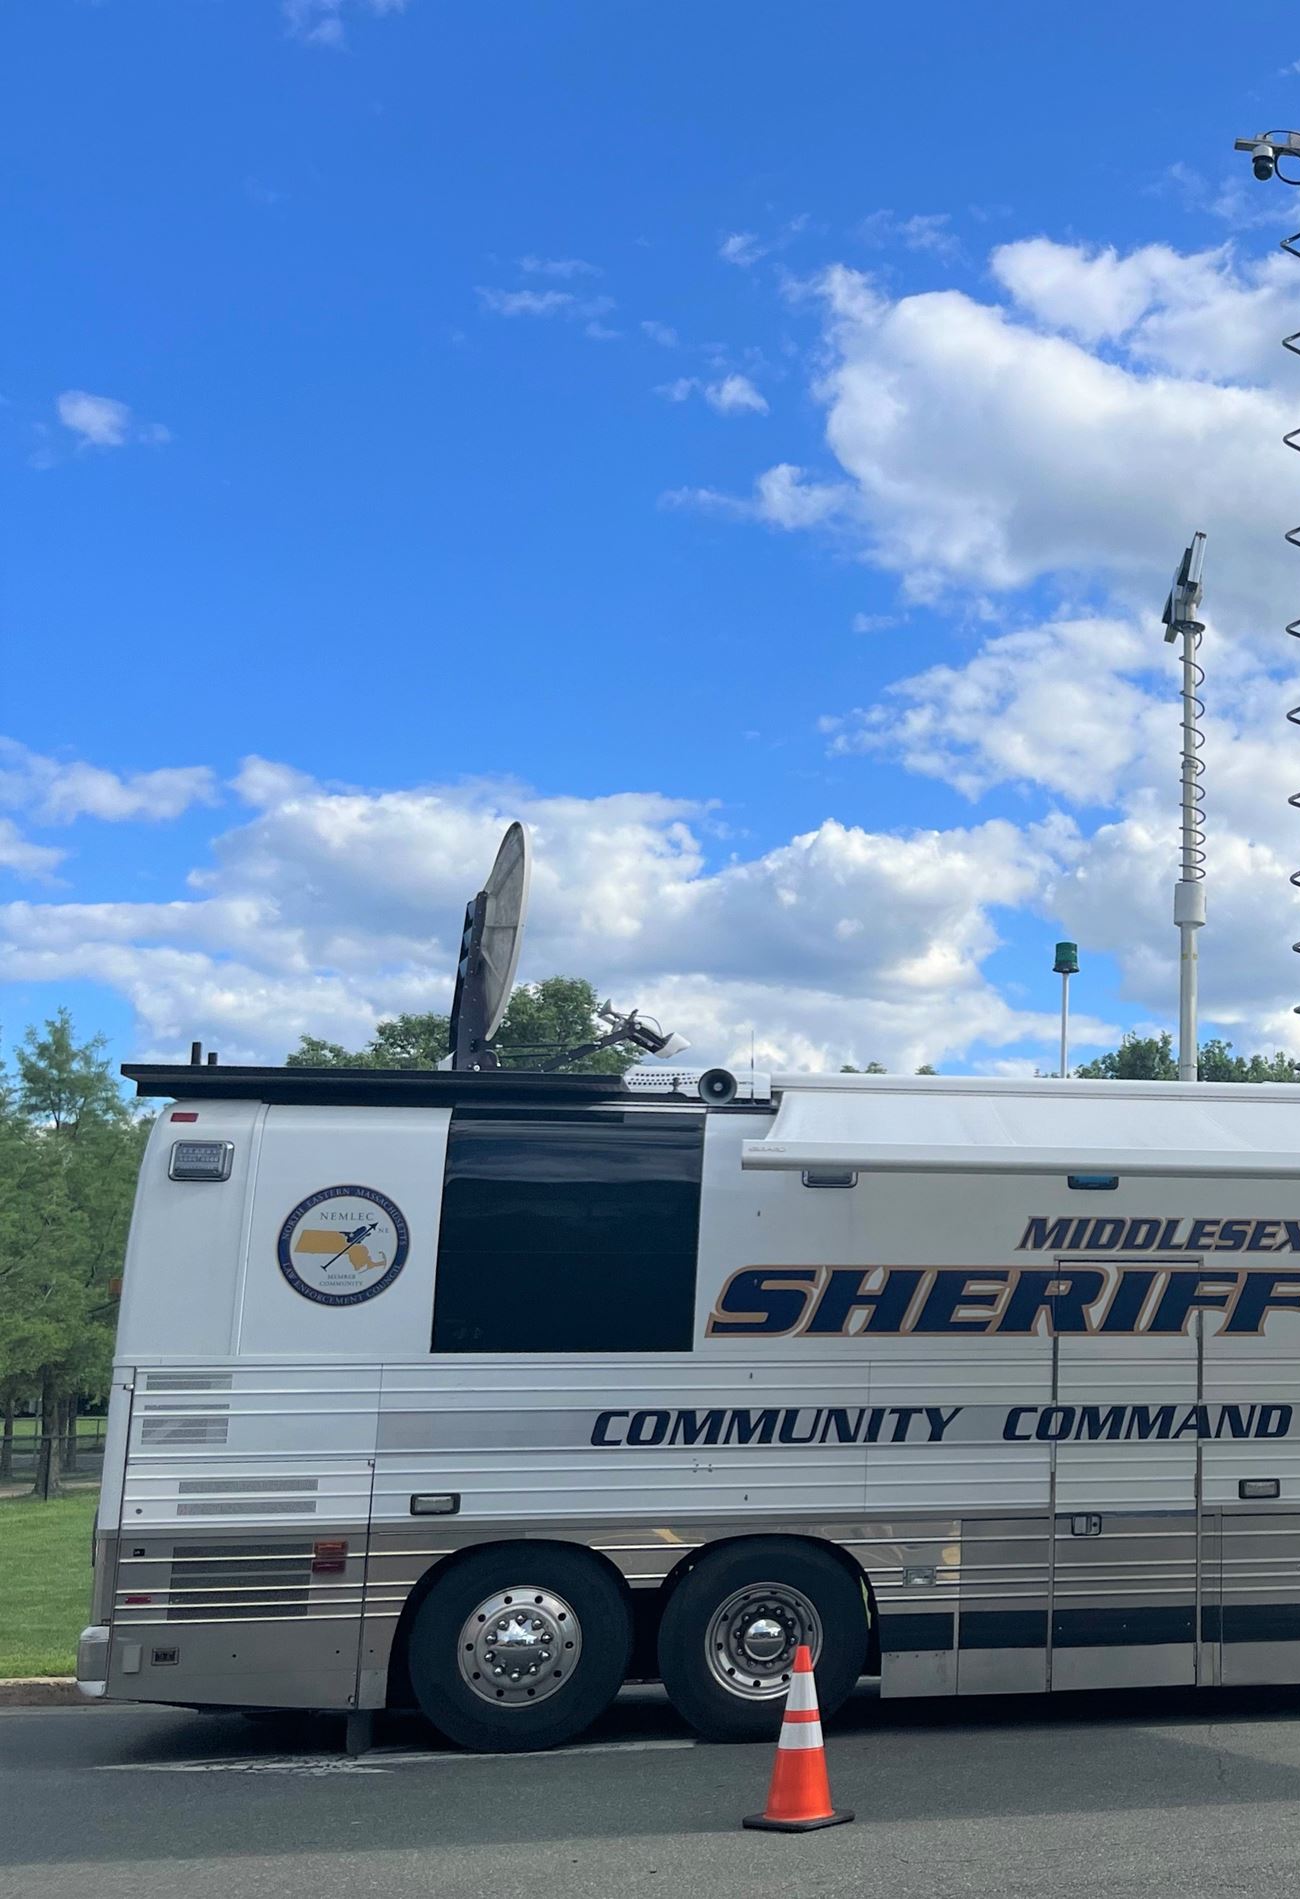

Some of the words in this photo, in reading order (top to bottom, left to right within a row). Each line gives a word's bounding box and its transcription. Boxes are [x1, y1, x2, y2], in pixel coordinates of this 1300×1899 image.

[306, 1188, 351, 1206] EASTERN
[320, 1212, 375, 1221] NEMLEC
[293, 1278, 365, 1305] ENFORCEMENT
[591, 1407, 964, 1447] COMMUNITY
[1002, 1404, 1293, 1442] COMMAND
